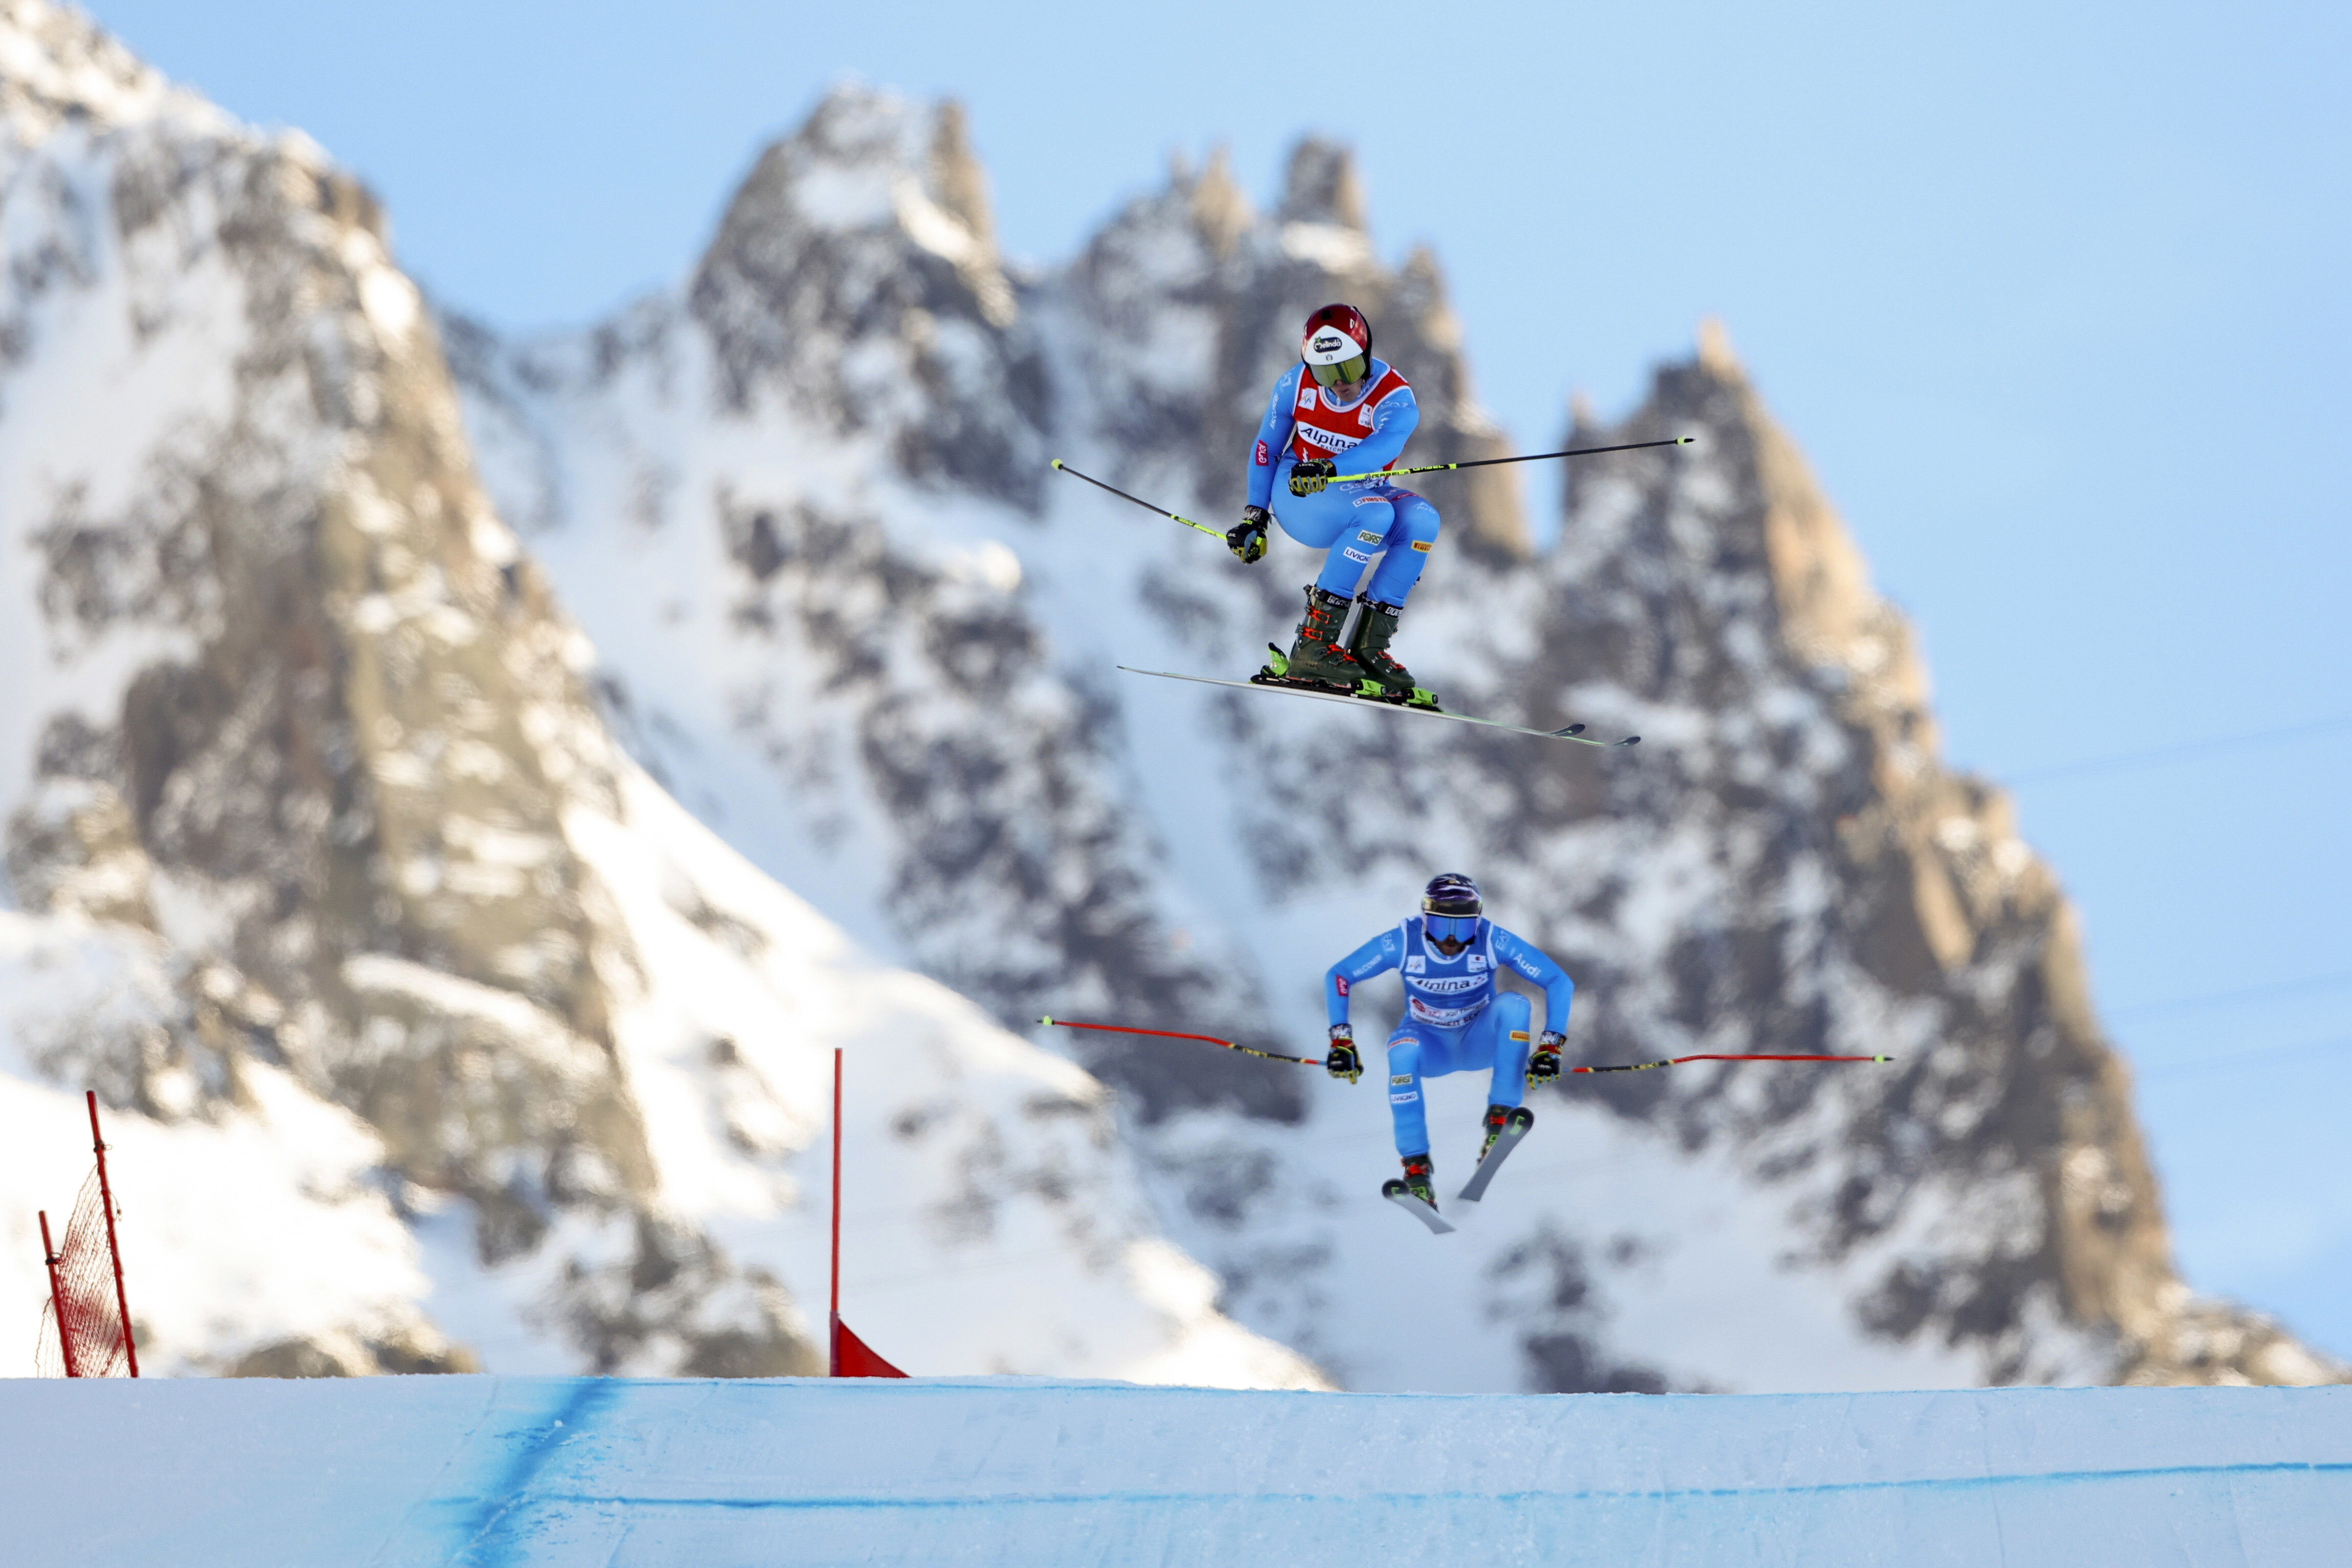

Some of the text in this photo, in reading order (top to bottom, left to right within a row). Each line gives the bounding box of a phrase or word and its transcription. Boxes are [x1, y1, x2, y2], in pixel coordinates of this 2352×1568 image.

[1314, 339, 1341, 350] Melinda
[1300, 428, 1357, 449] Alpina
[1321, 444, 1346, 452] WATCHE
[1346, 549, 1370, 562] LIVIGN
[1513, 953, 1542, 978] Audi
